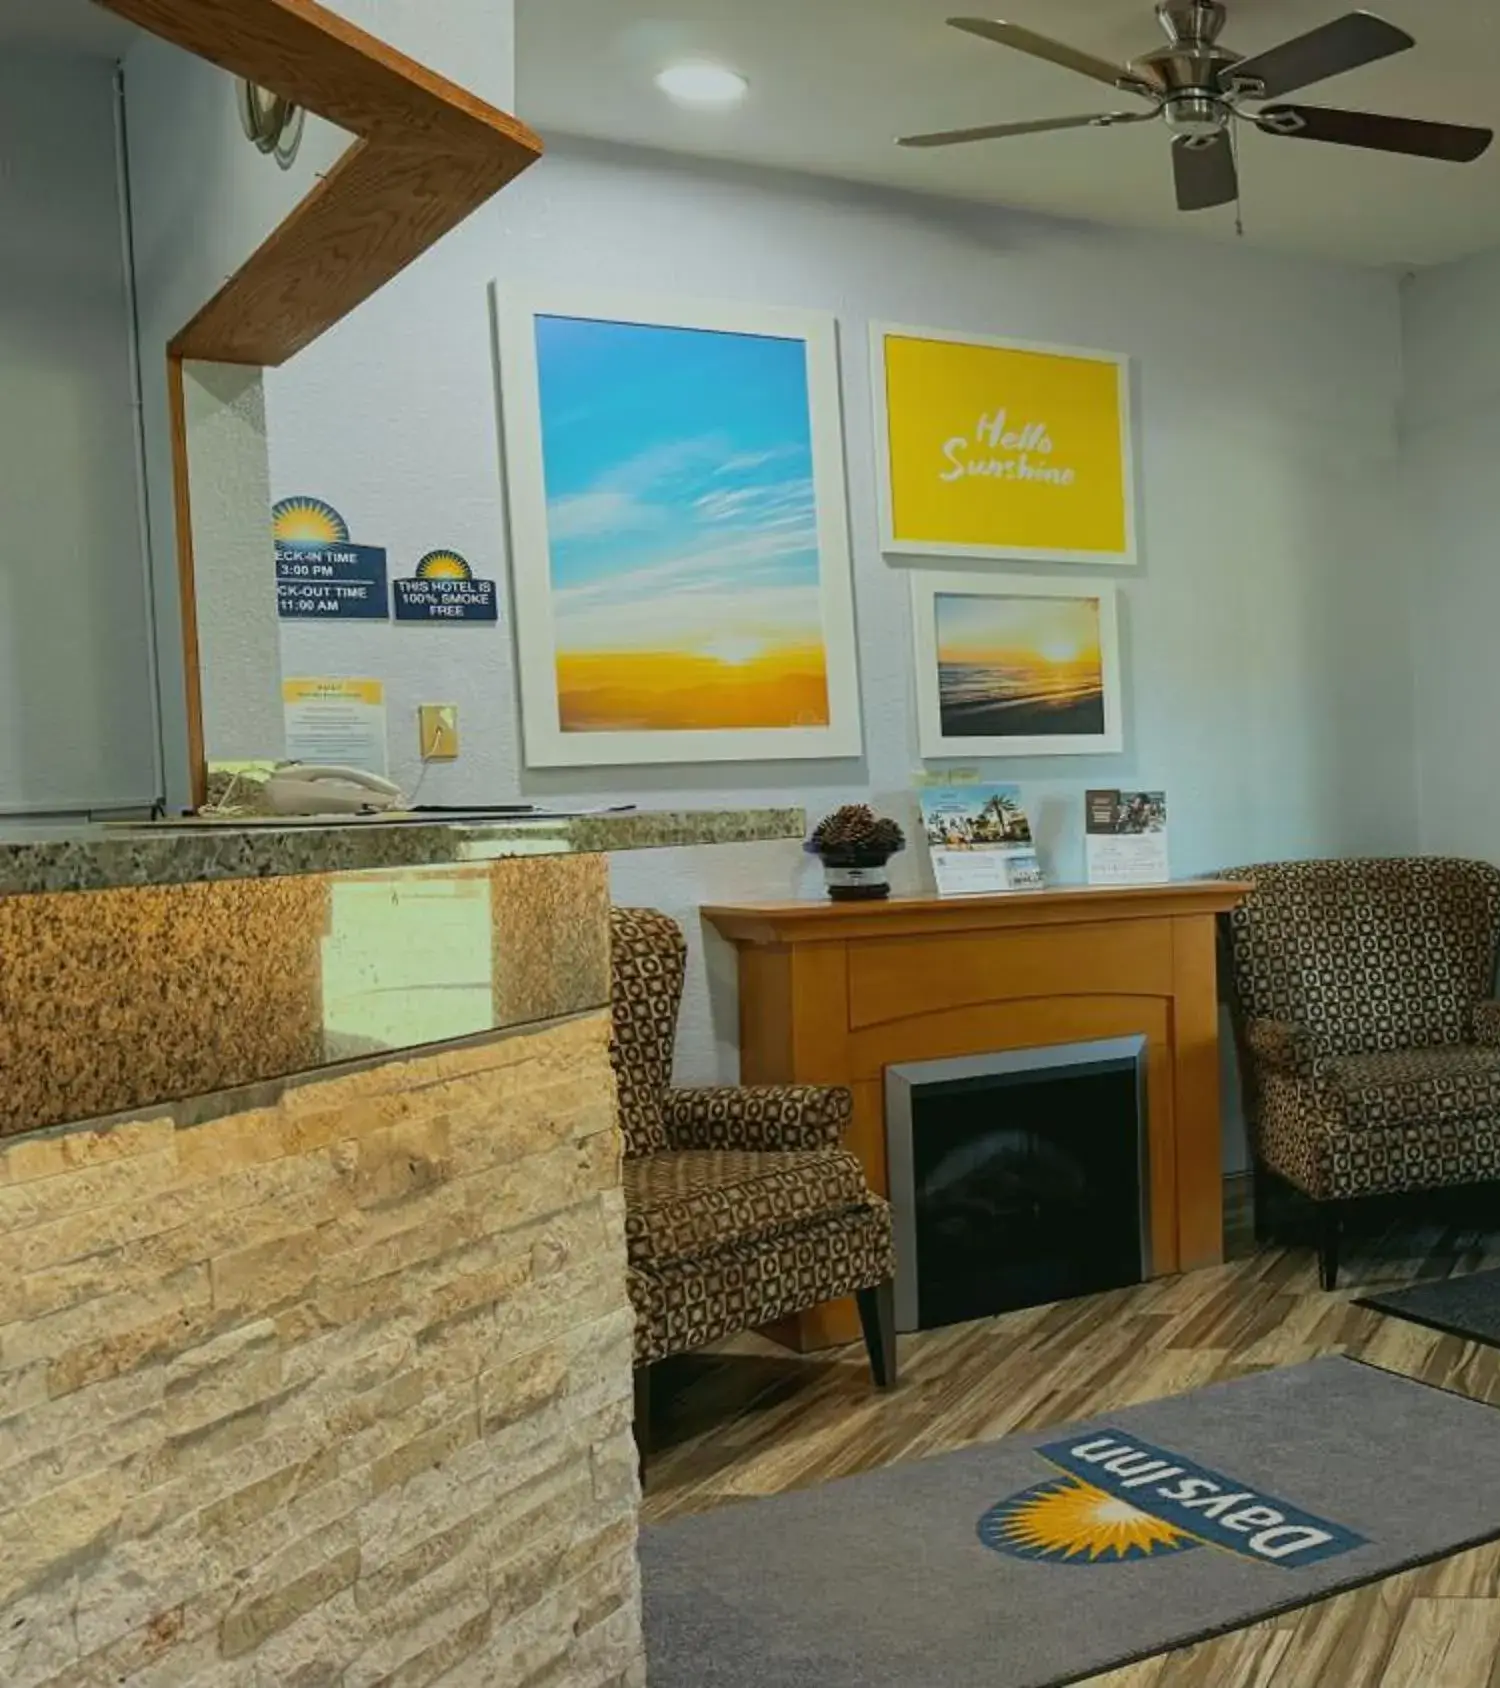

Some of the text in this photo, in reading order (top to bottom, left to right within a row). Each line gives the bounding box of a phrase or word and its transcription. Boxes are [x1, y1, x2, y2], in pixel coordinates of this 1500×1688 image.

[976, 407, 1052, 453] Hello
[941, 437, 1075, 485] Sunshine
[325, 551, 358, 564] TIME
[281, 564, 333, 576] 3:00 PM
[400, 581, 491, 592] THIS HOTEL IS
[336, 587, 368, 599] TIME
[402, 593, 489, 605] 100% SMOKE
[281, 599, 339, 611] 11:00 AM
[430, 605, 465, 616] FREE
[1071, 1438, 1334, 1558] Days Inn
